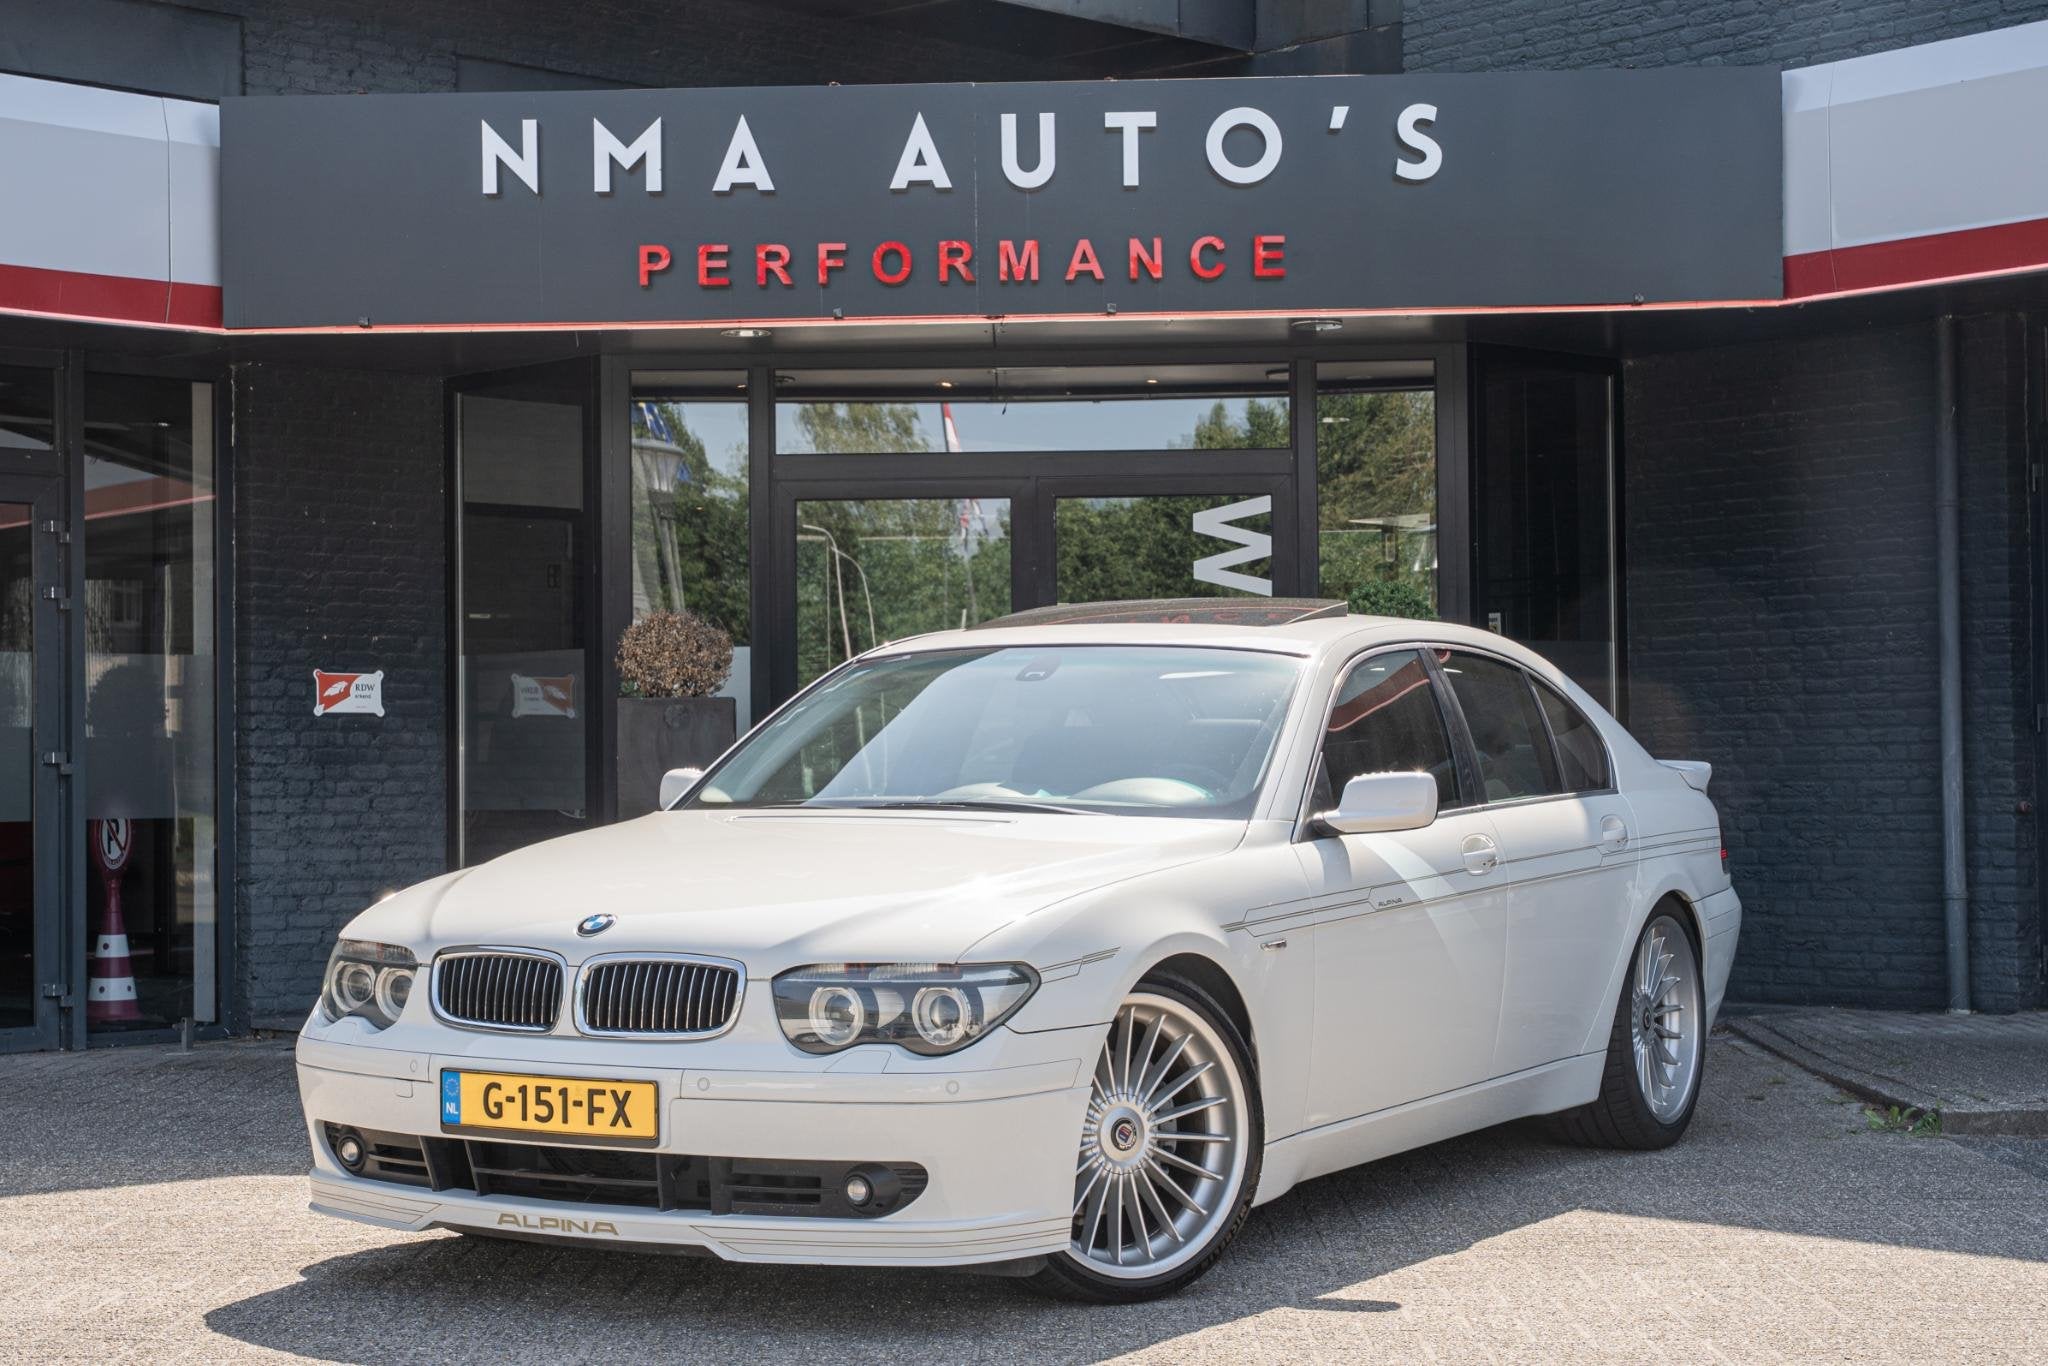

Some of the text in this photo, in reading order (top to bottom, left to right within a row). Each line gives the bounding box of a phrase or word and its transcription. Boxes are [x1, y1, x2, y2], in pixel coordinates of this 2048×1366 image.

[480, 103, 1443, 195] NMA AUTO'S
[638, 234, 1287, 287] PERFORMANCE
[355, 683, 375, 691] RDW
[445, 1102, 459, 1115] NL
[482, 1081, 633, 1129] G-151-FX
[497, 1212, 619, 1236] ALPINA
